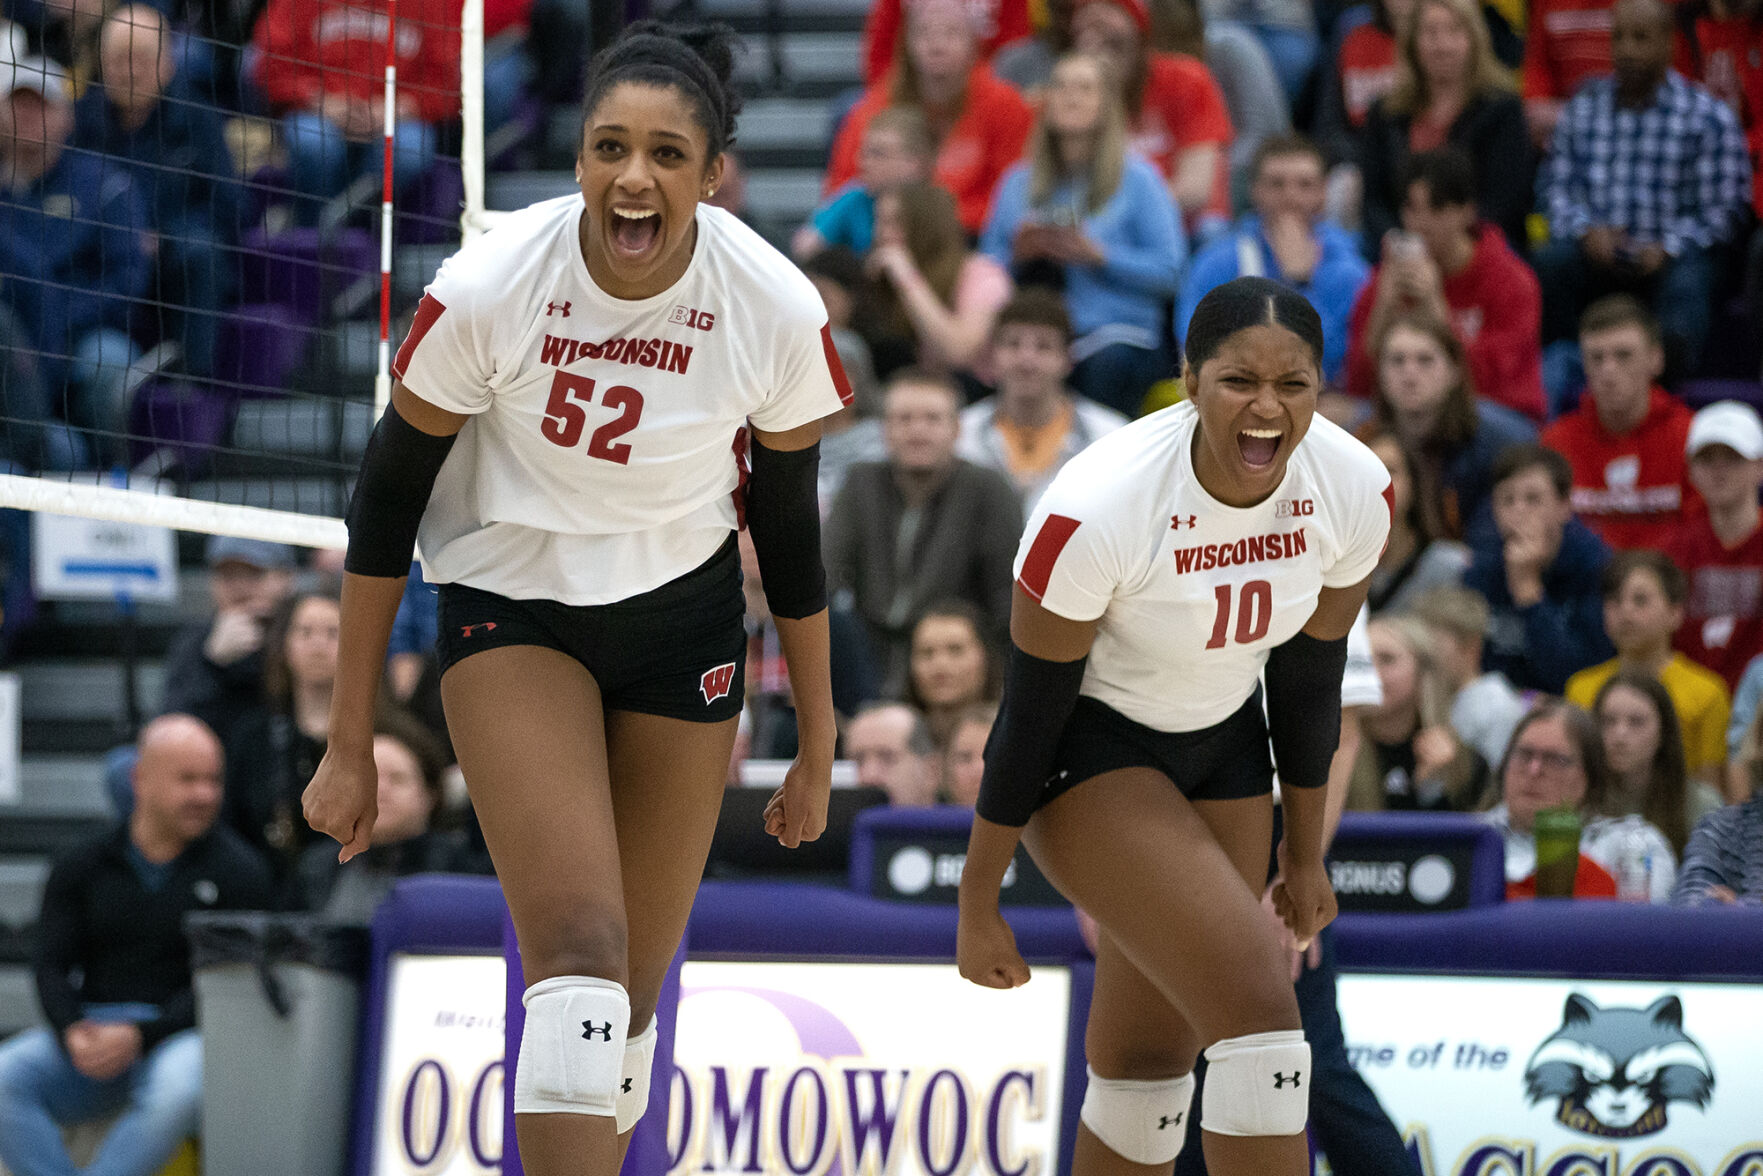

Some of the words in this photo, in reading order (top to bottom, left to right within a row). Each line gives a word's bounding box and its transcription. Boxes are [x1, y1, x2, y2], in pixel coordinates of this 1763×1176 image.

[541, 369, 644, 465] 52
[1174, 528, 1307, 575] WISCONSIN
[1205, 580, 1272, 650] 10
[699, 662, 736, 706] W
[1407, 1043, 1445, 1069] of
[1455, 1043, 1508, 1070] the
